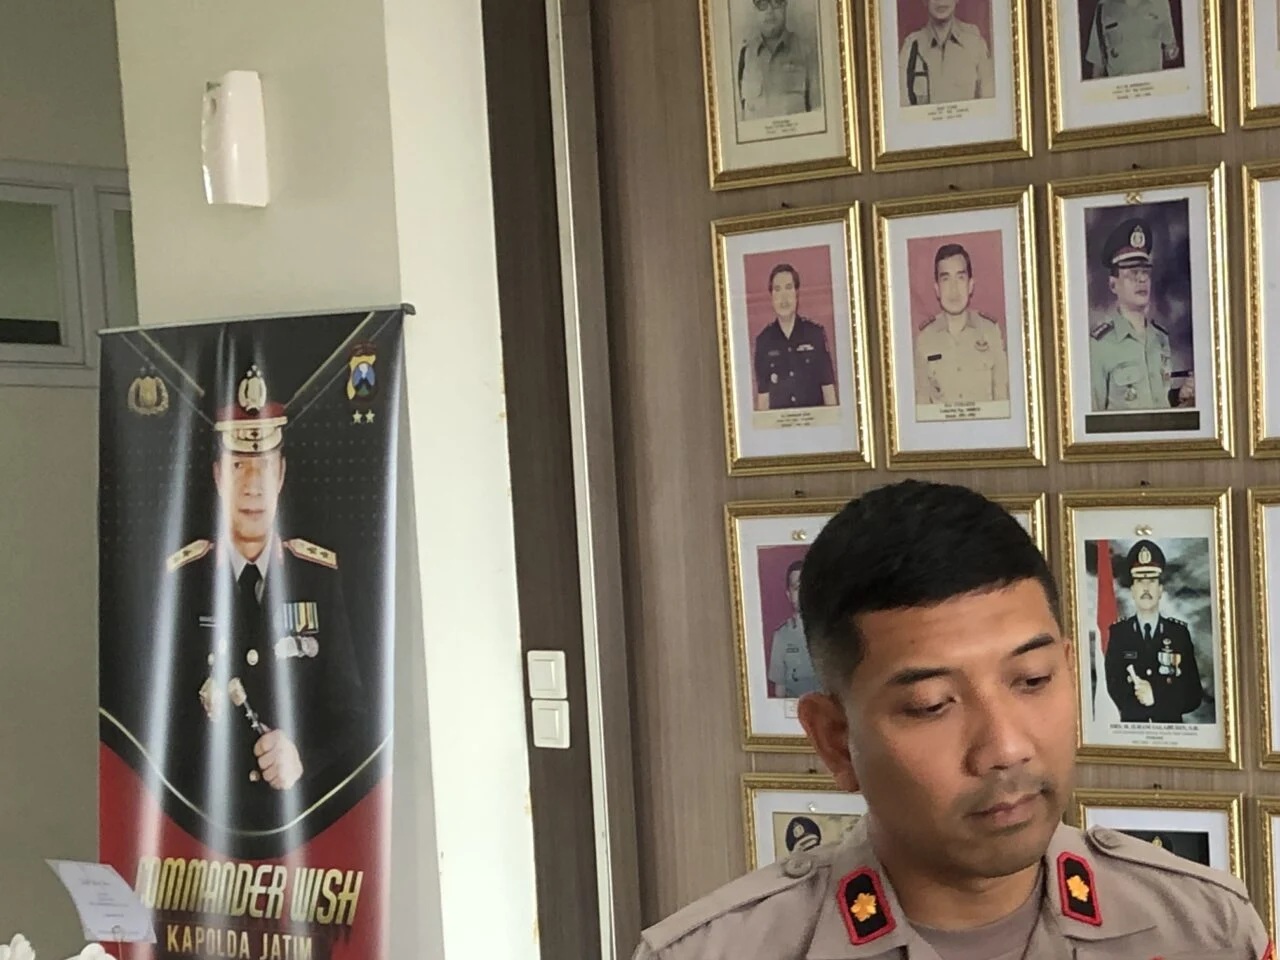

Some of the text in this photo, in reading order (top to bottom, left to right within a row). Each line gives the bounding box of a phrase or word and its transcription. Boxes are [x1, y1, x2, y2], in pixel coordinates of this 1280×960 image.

[135, 856, 288, 919] COMMANDER
[290, 867, 364, 926] WISH
[167, 924, 250, 960] KAPOLDA
